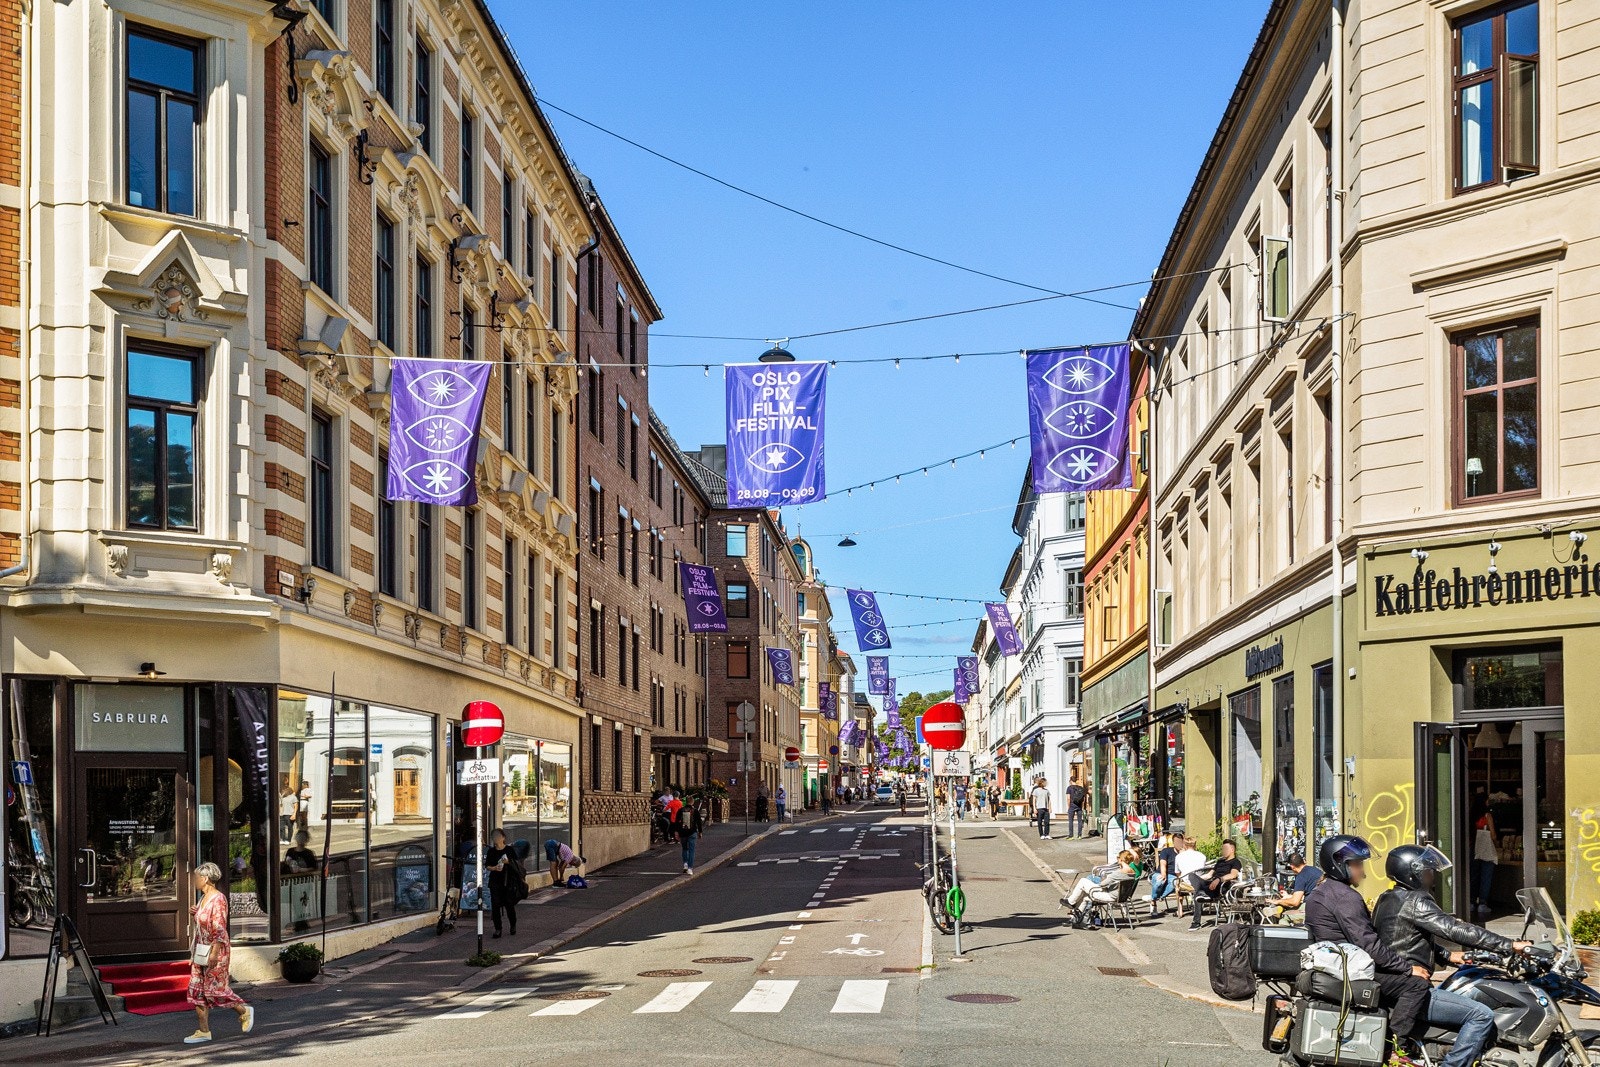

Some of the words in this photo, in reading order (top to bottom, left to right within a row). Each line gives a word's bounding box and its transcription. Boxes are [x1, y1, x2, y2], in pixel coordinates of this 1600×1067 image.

[752, 372, 801, 386] OSLO
[762, 387, 790, 400] PIX
[736, 416, 817, 432] FESTIVAL
[688, 568, 706, 576] OSLO
[688, 588, 719, 597] FESTIVAL
[92, 712, 169, 724] SABRURA
